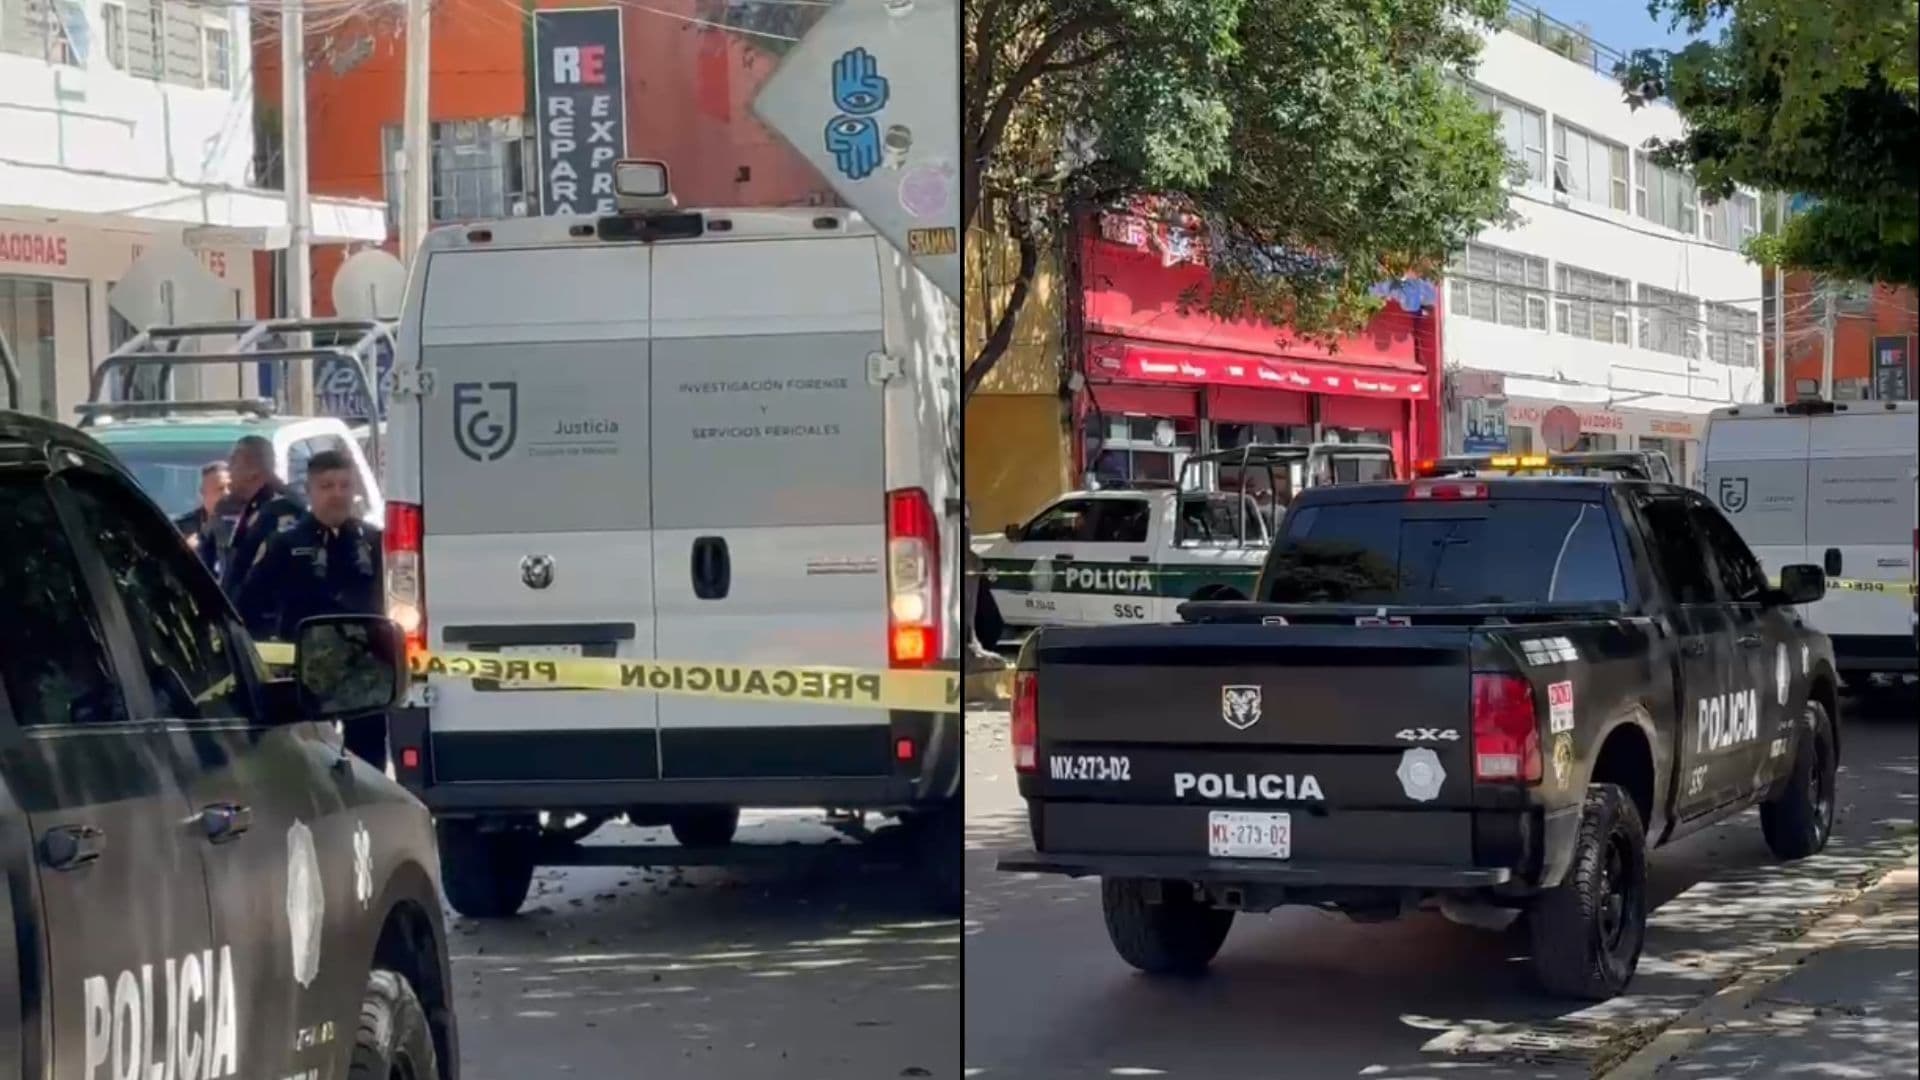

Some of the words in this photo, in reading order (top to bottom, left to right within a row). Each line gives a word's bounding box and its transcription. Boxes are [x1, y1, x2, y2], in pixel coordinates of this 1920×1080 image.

[552, 45, 606, 84] RE
[679, 380, 783, 393] INVESTIGACIÓN
[786, 377, 848, 391] FORENSE
[554, 420, 619, 435] Justicia
[692, 427, 761, 440] SERVICIOS
[764, 424, 840, 437] PERICIALES
[1065, 567, 1152, 591] POLICIA
[1113, 603, 1145, 619] SSC
[1697, 688, 1757, 754] POLICIA
[1174, 772, 1325, 800] POLICIA
[84, 944, 236, 1080] POLICIA
